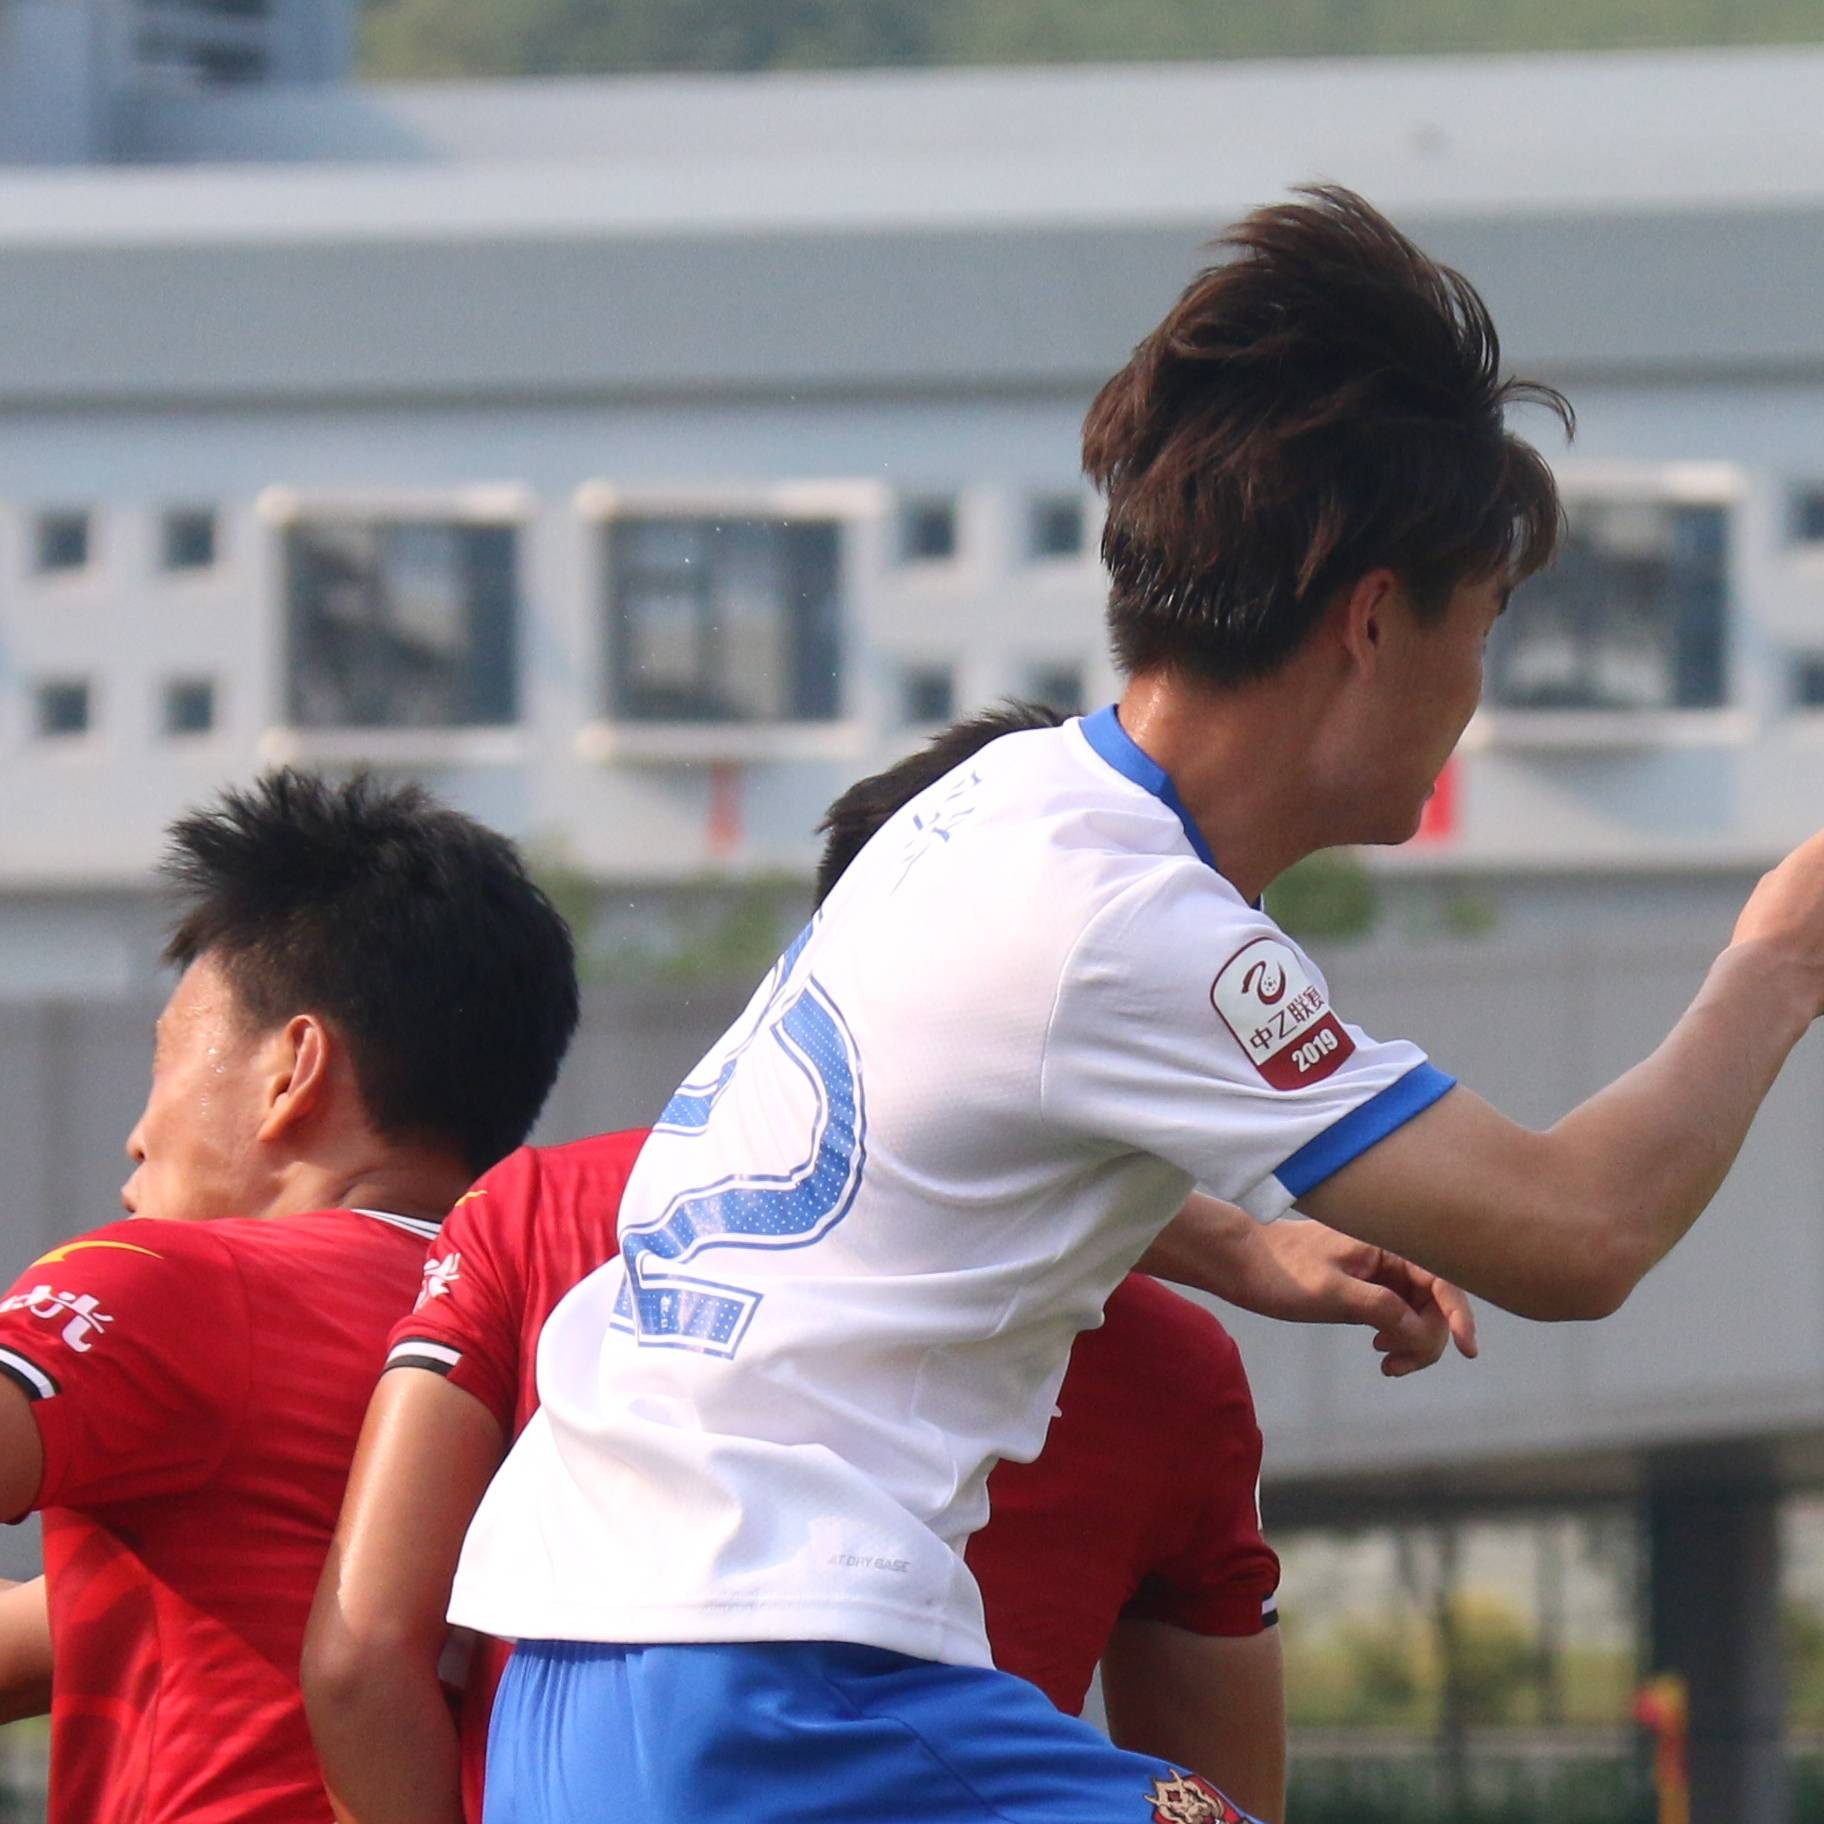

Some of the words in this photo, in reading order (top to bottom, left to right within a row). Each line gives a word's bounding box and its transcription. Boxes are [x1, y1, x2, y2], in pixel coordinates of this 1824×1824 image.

[1249, 984, 1326, 1050] 中乙联赛
[1291, 1027, 1339, 1073] 2019
